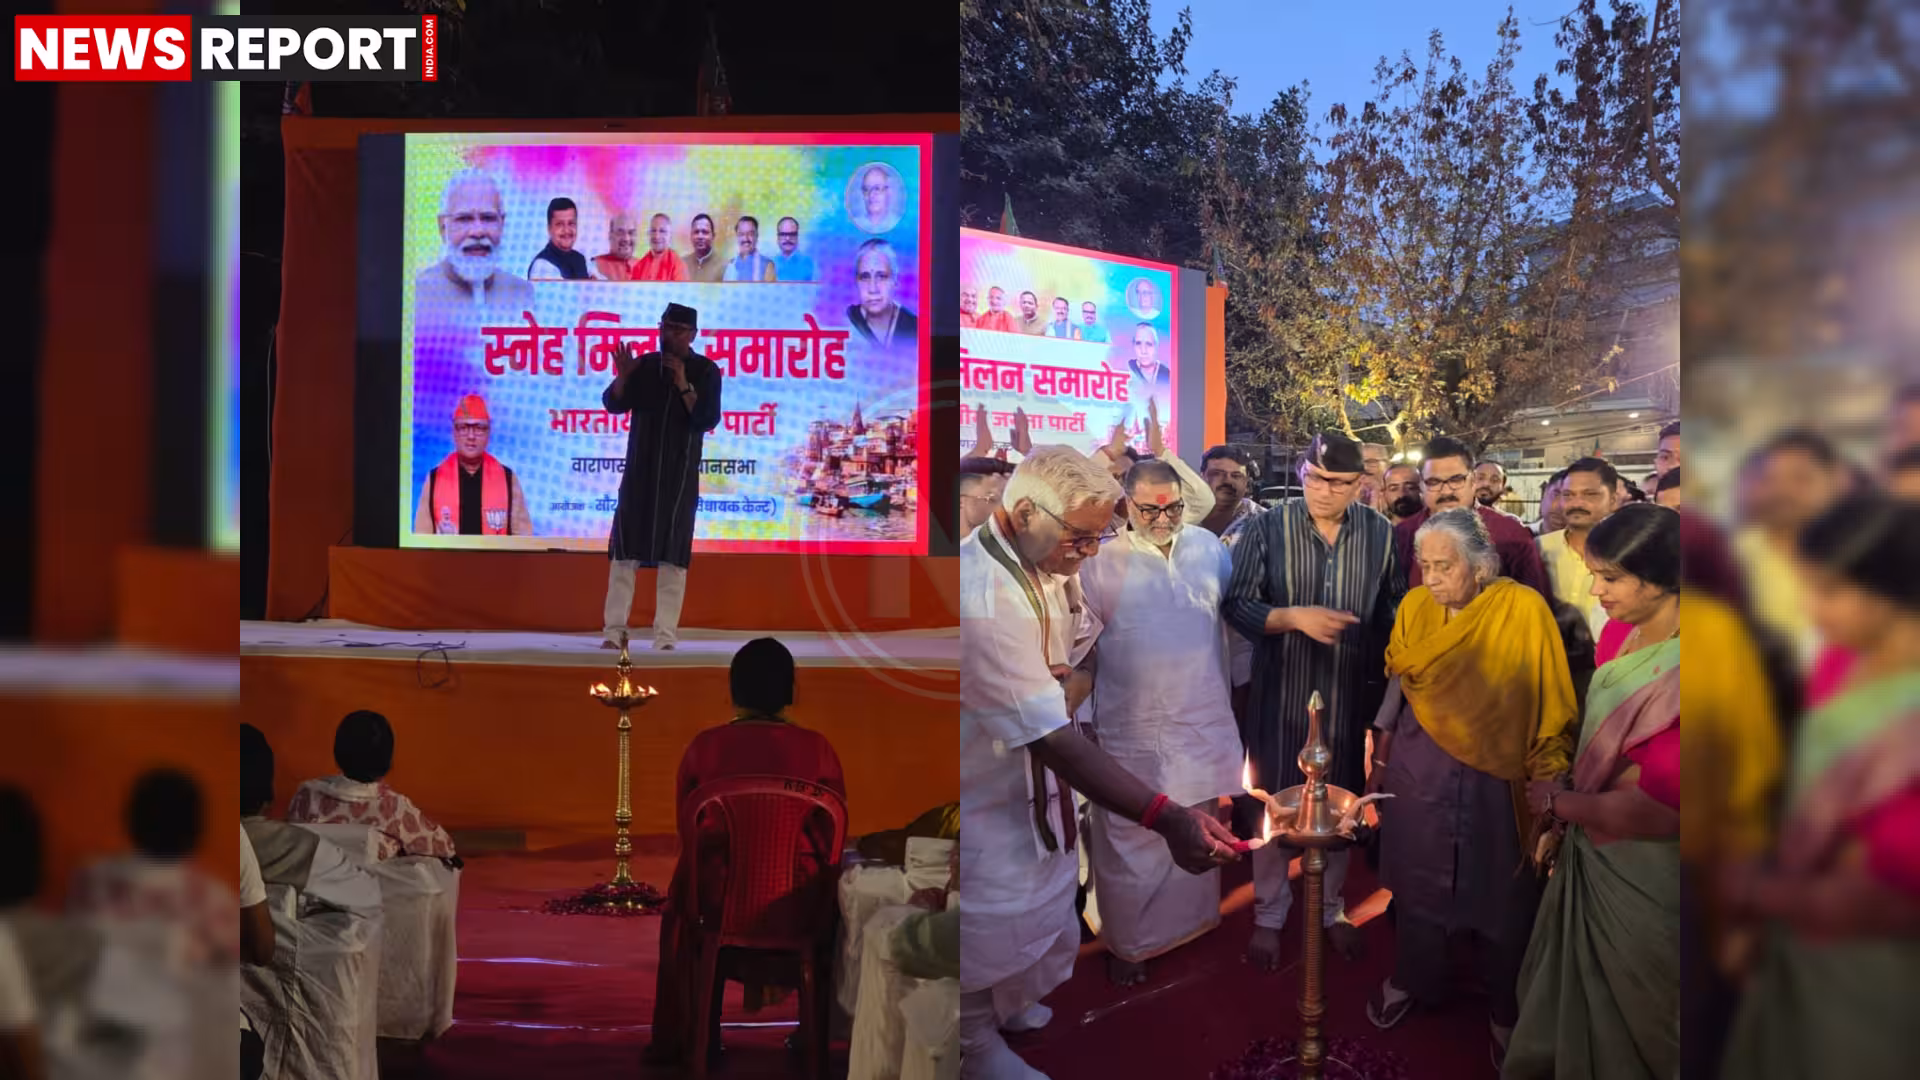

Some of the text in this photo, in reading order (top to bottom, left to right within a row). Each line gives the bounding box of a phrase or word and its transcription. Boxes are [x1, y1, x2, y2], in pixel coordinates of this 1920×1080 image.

[481, 311, 849, 379] स्नेह मिल समारोह
[1030, 361, 1130, 402] समारोह
[722, 403, 778, 436] पार्टी
[1047, 412, 1086, 432] पार्टी
[571, 457, 627, 473] वाराणस
